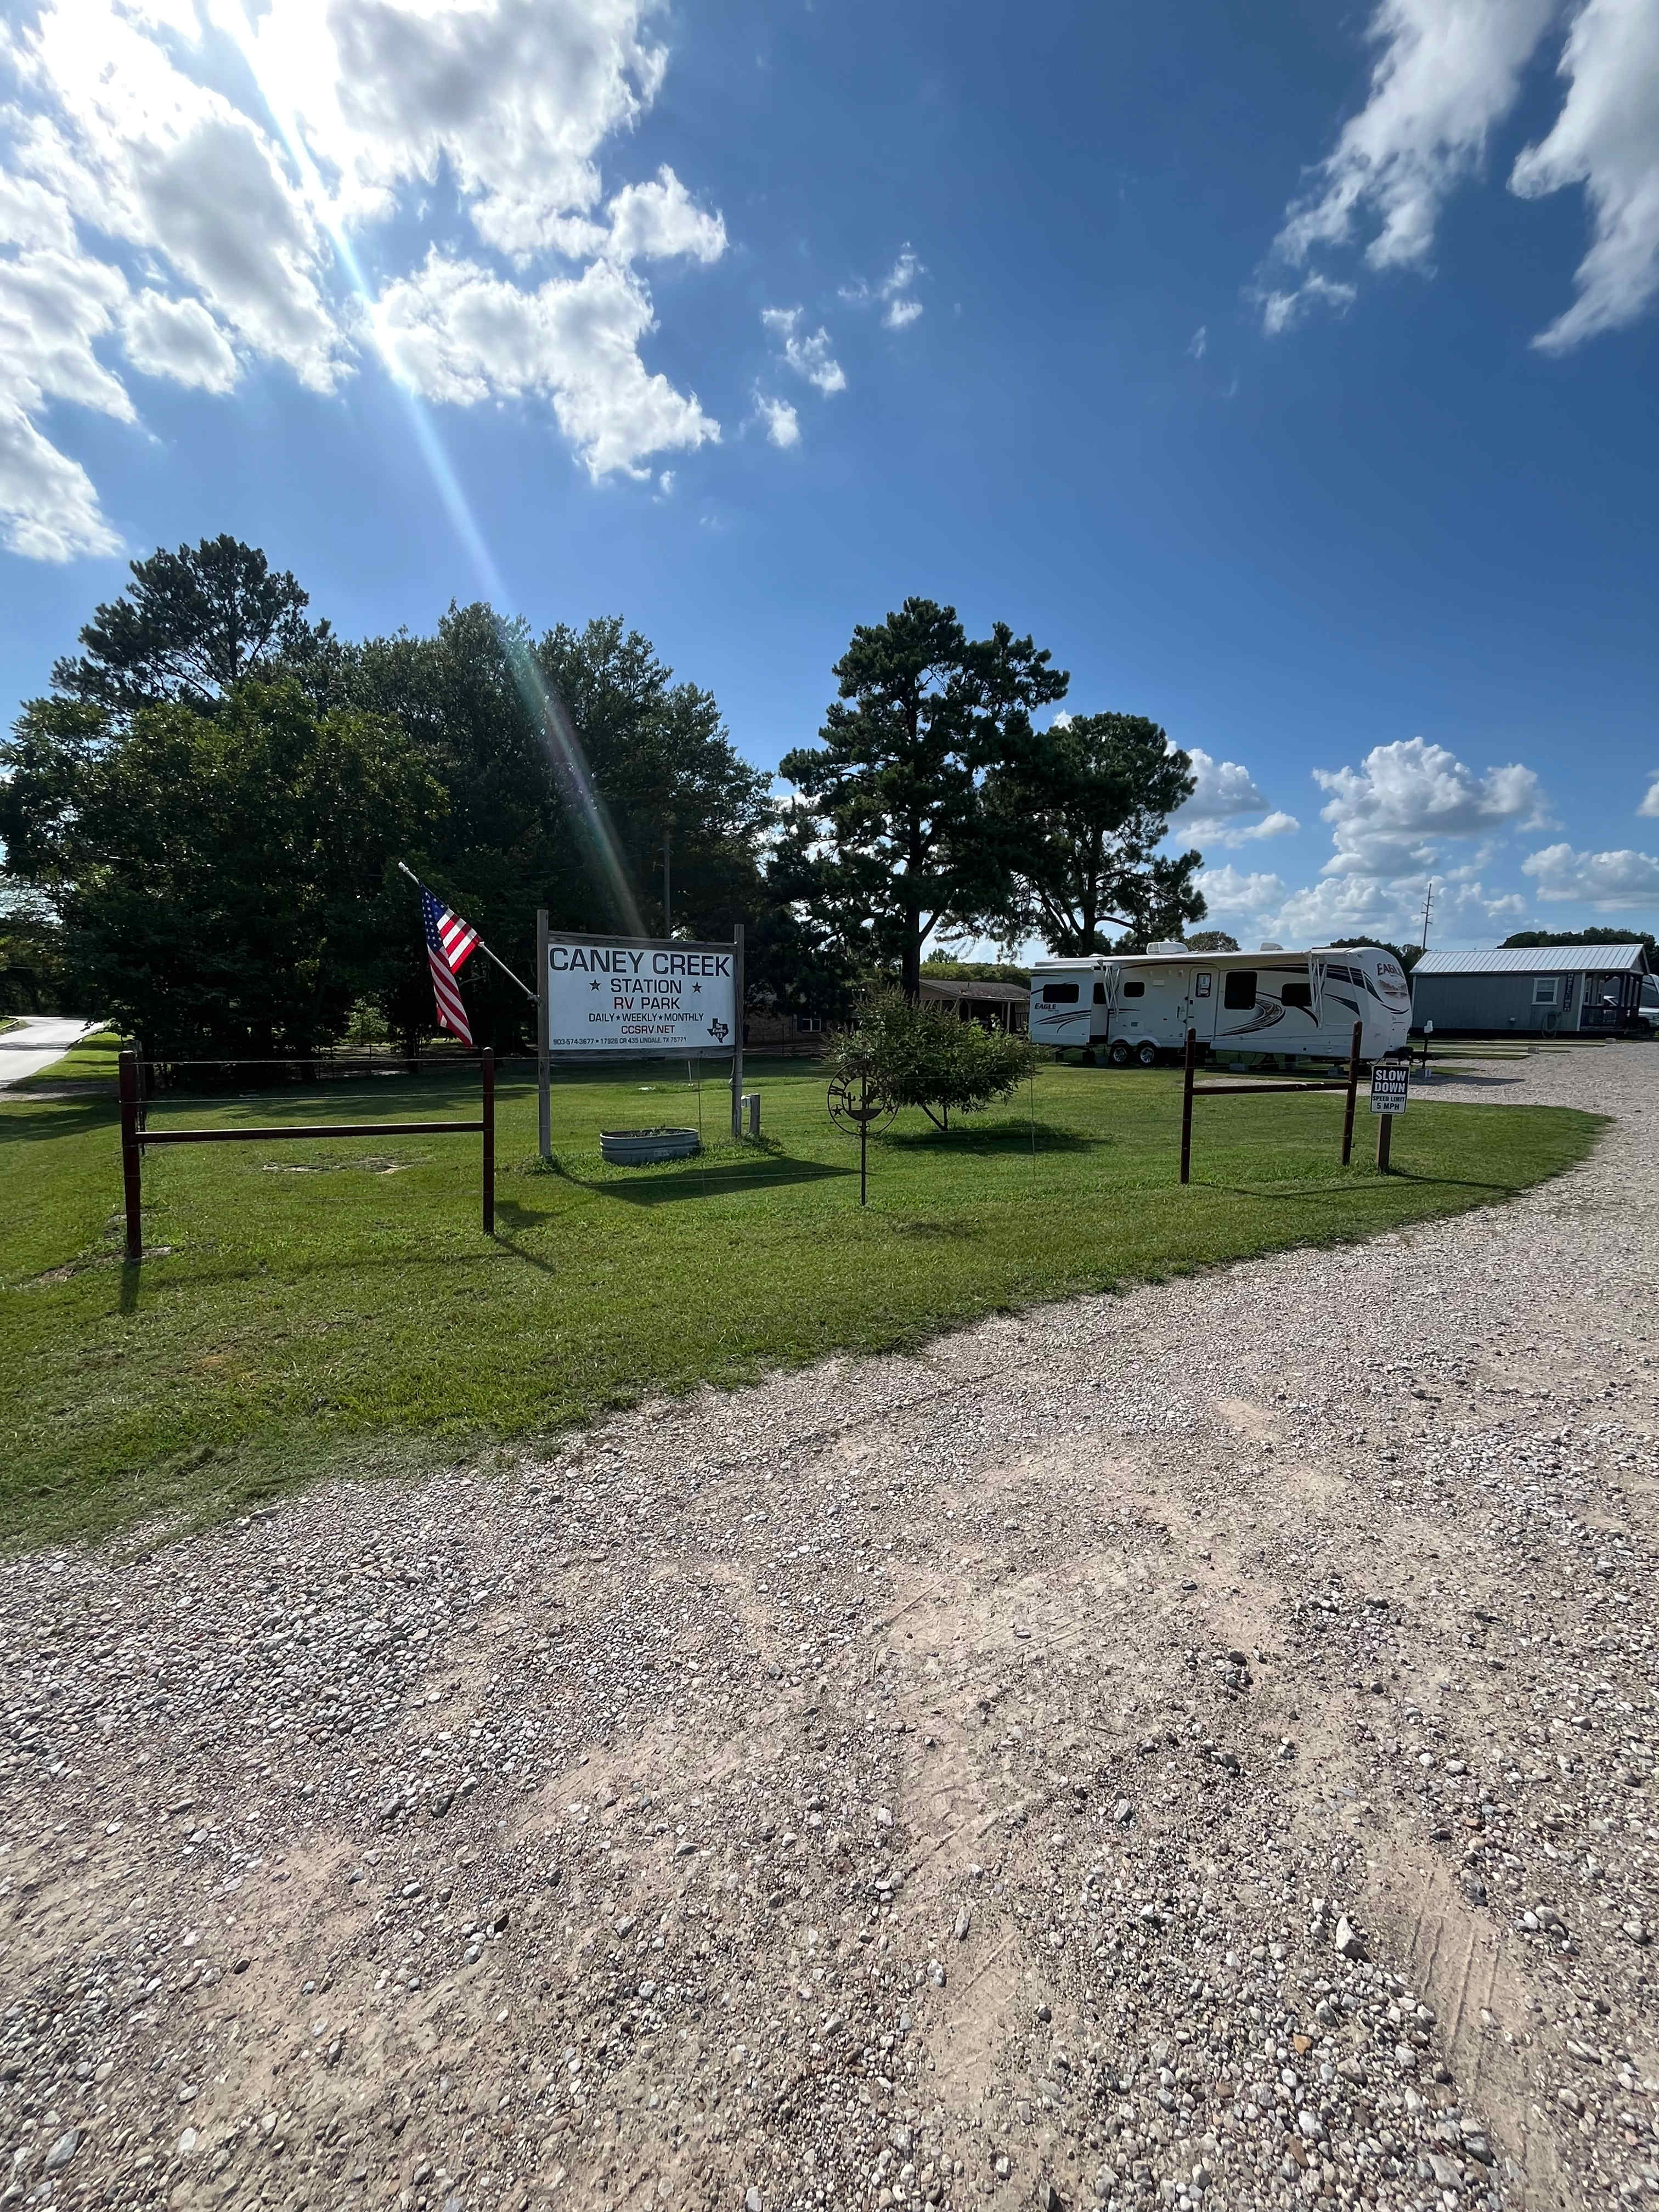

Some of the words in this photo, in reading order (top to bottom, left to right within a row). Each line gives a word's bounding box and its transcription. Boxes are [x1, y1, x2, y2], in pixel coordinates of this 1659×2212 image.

[550, 947, 645, 974] CANEY
[653, 953, 730, 977] CREEK
[611, 978, 681, 994] STATION
[614, 997, 634, 1009] RV
[641, 997, 680, 1009] PARK
[589, 1013, 614, 1022] DAILY
[622, 1013, 657, 1022] WEEKLY
[664, 1013, 703, 1021] MONTHLY
[622, 1025, 675, 1034] CCSRV.NET
[1375, 1070, 1406, 1081] SLOW
[1374, 1082, 1405, 1092] DOWN
